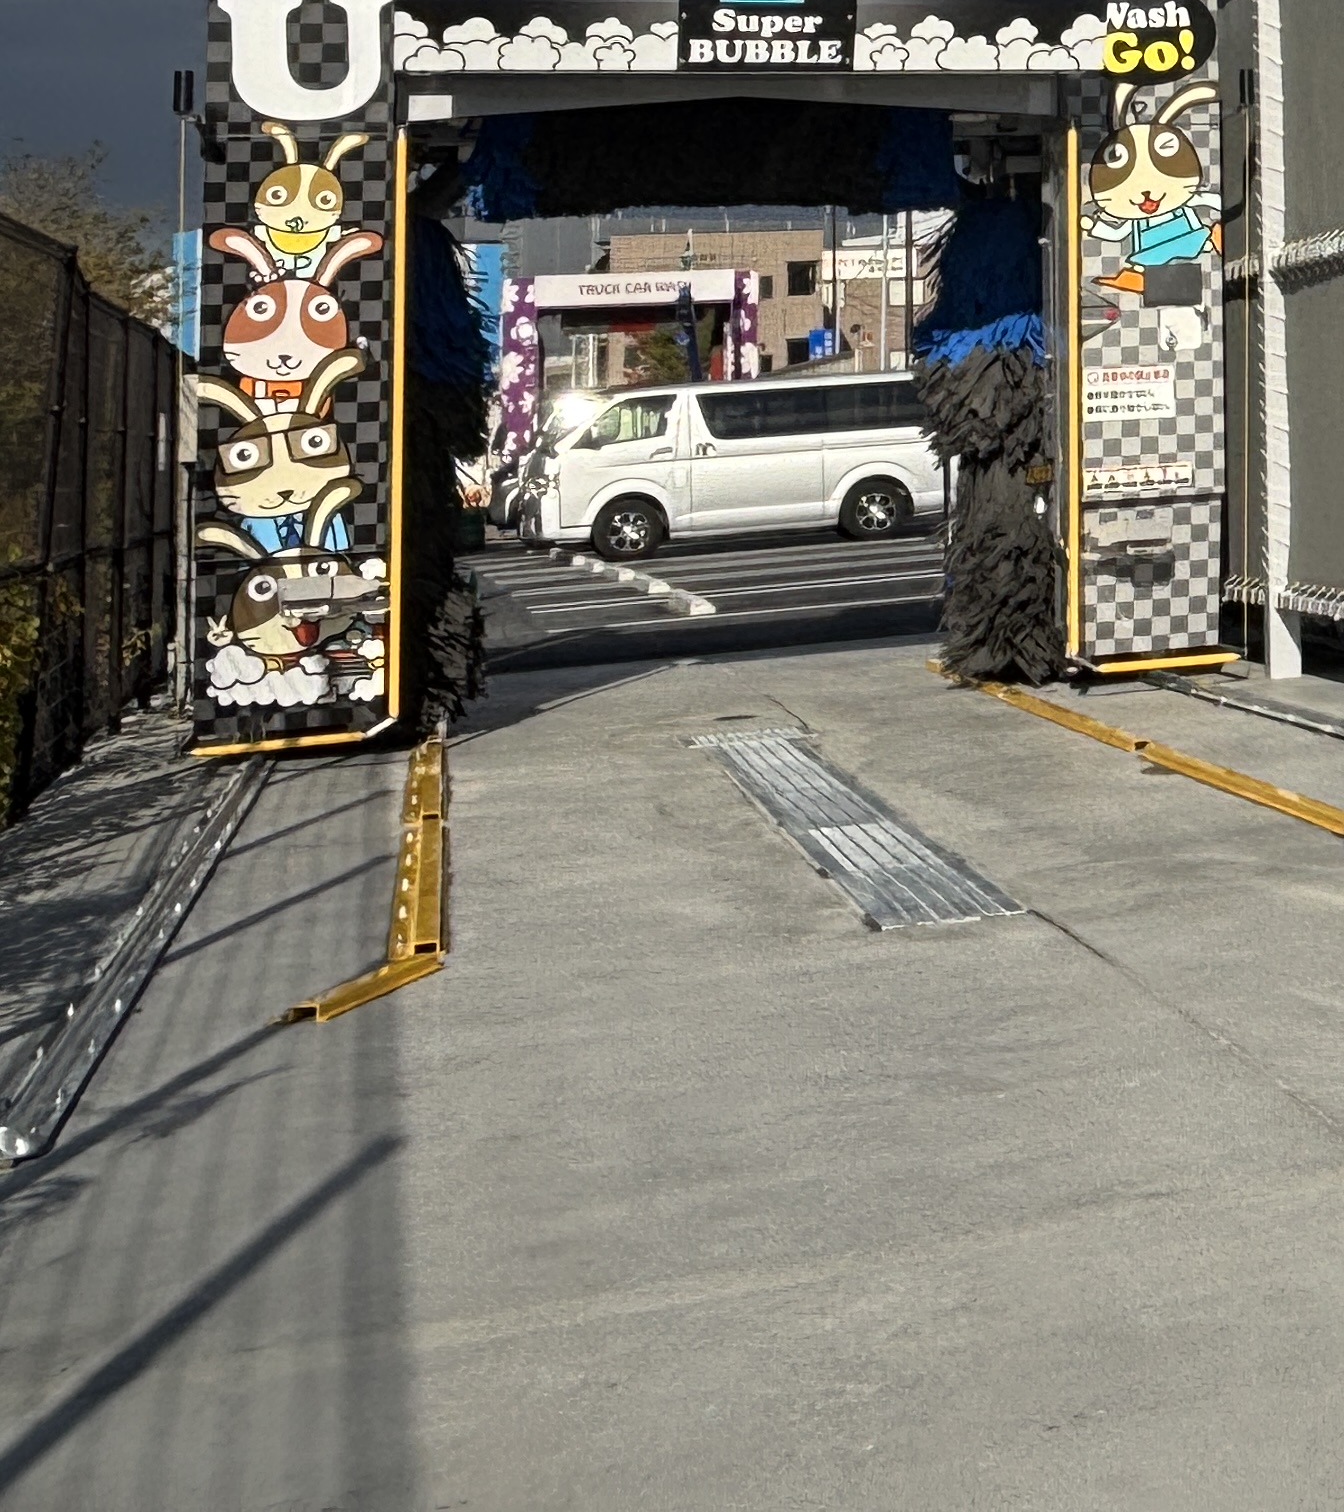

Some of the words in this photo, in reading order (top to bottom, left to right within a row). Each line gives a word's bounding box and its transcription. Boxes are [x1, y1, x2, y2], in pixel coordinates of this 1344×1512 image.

[712, 8, 823, 37] Super
[688, 39, 843, 63] BUBBLE
[1104, 29, 1195, 73] Go!
